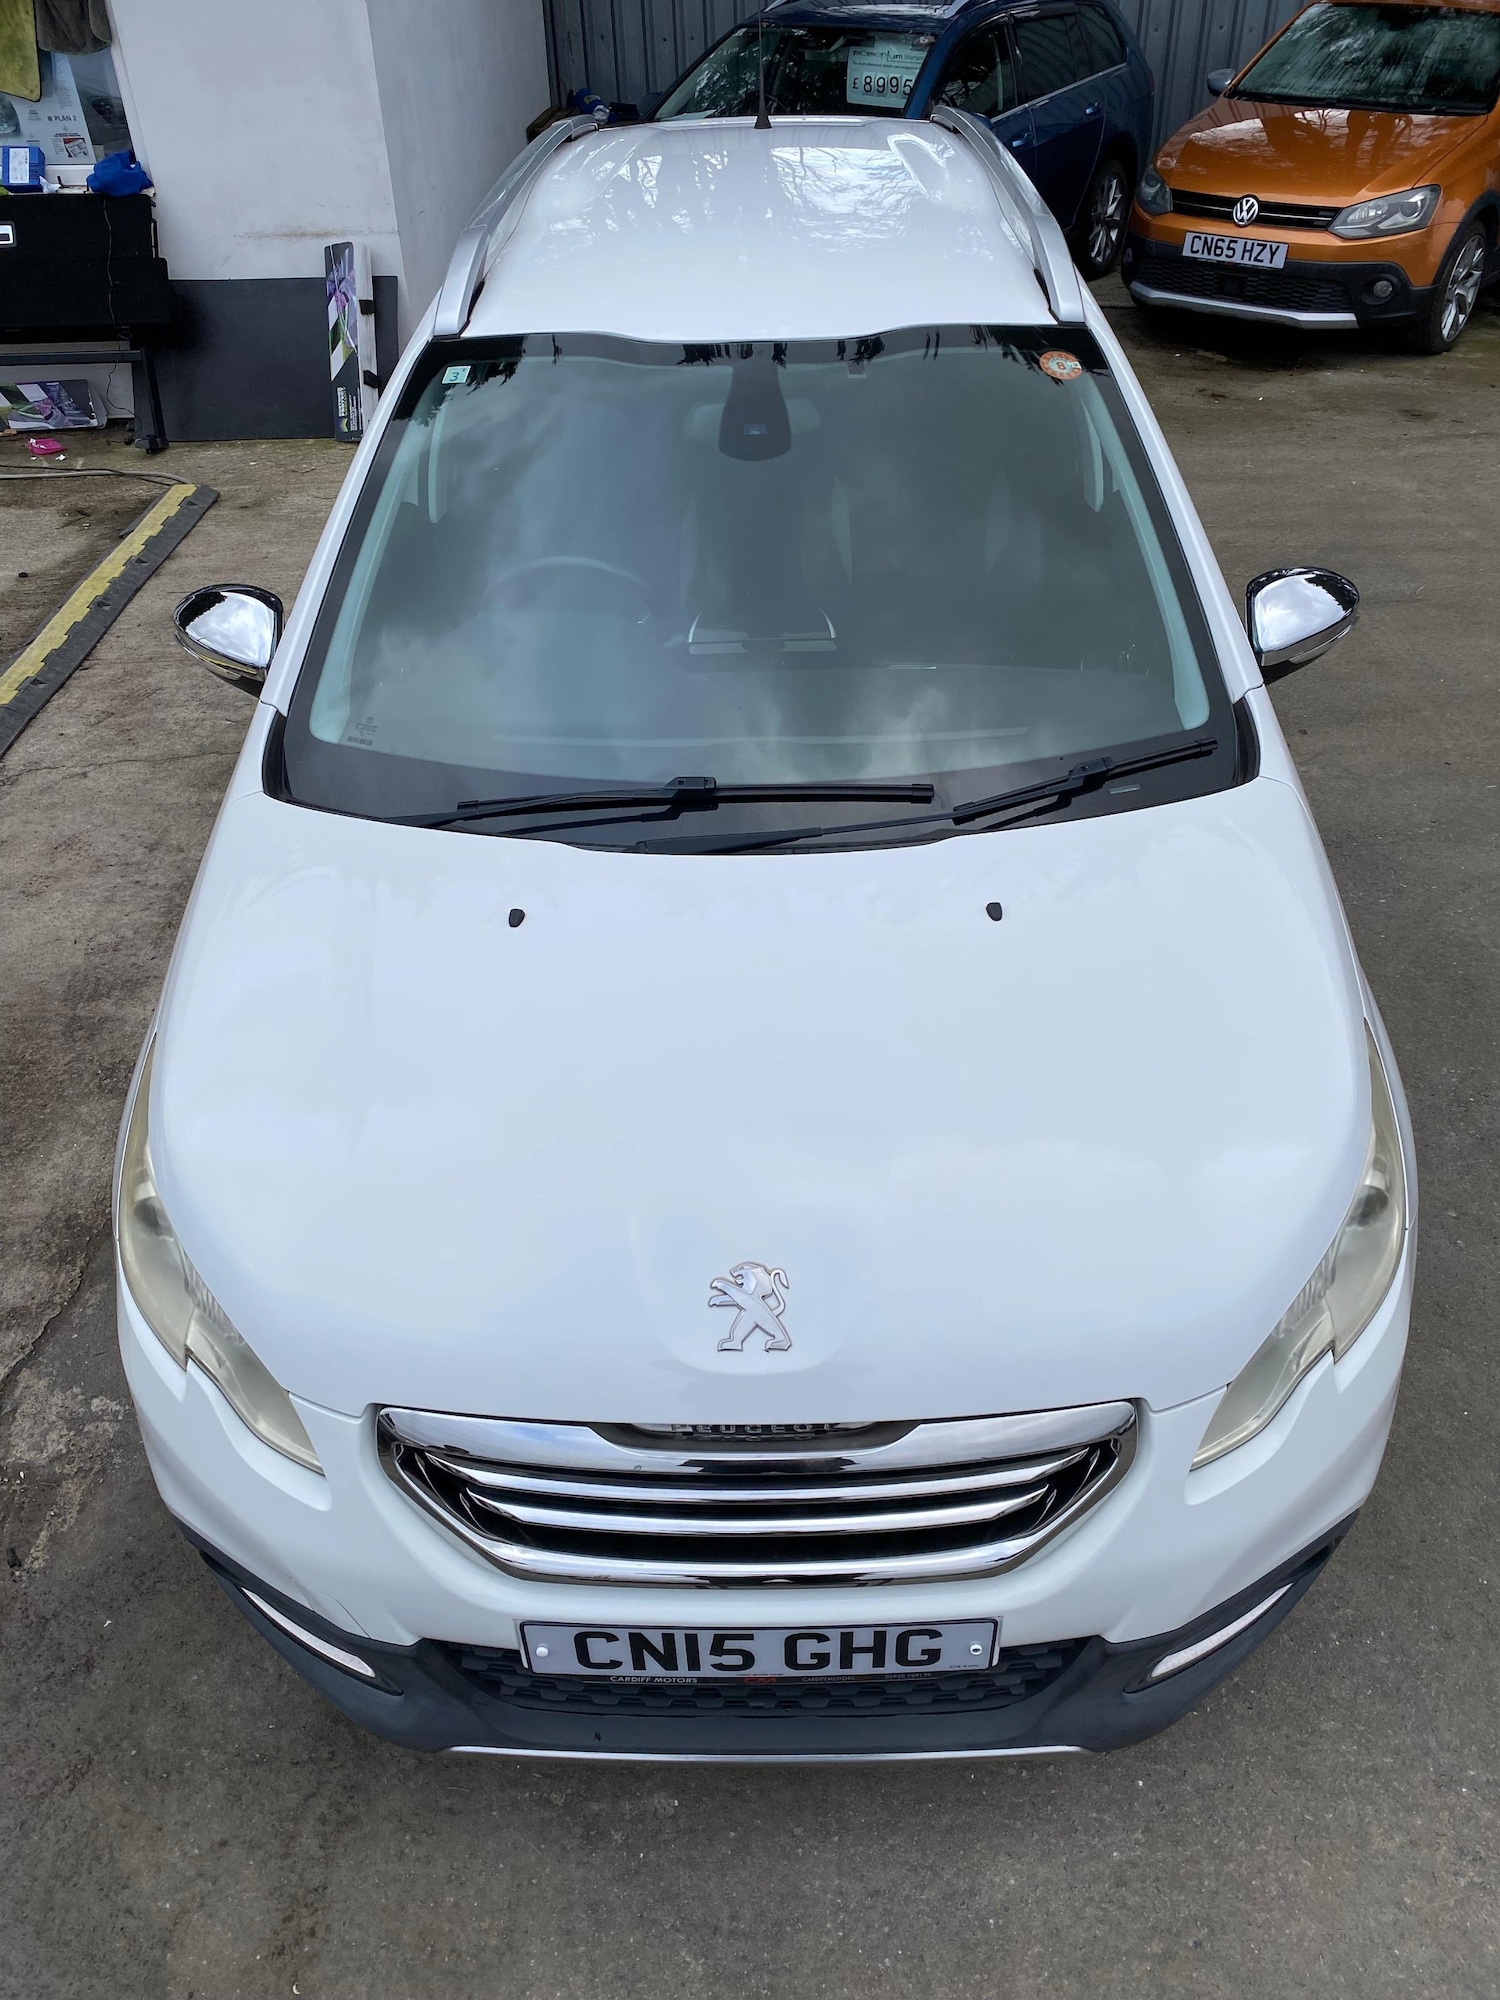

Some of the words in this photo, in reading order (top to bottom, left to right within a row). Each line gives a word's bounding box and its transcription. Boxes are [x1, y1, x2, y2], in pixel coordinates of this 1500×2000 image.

[1190, 235, 1239, 259] CN65
[1240, 241, 1280, 264] HZY
[573, 1631, 756, 1672] CN15
[784, 1628, 943, 1671] GHG
[609, 1675, 650, 1683] CARDIFF
[653, 1676, 698, 1684] MOTORS
